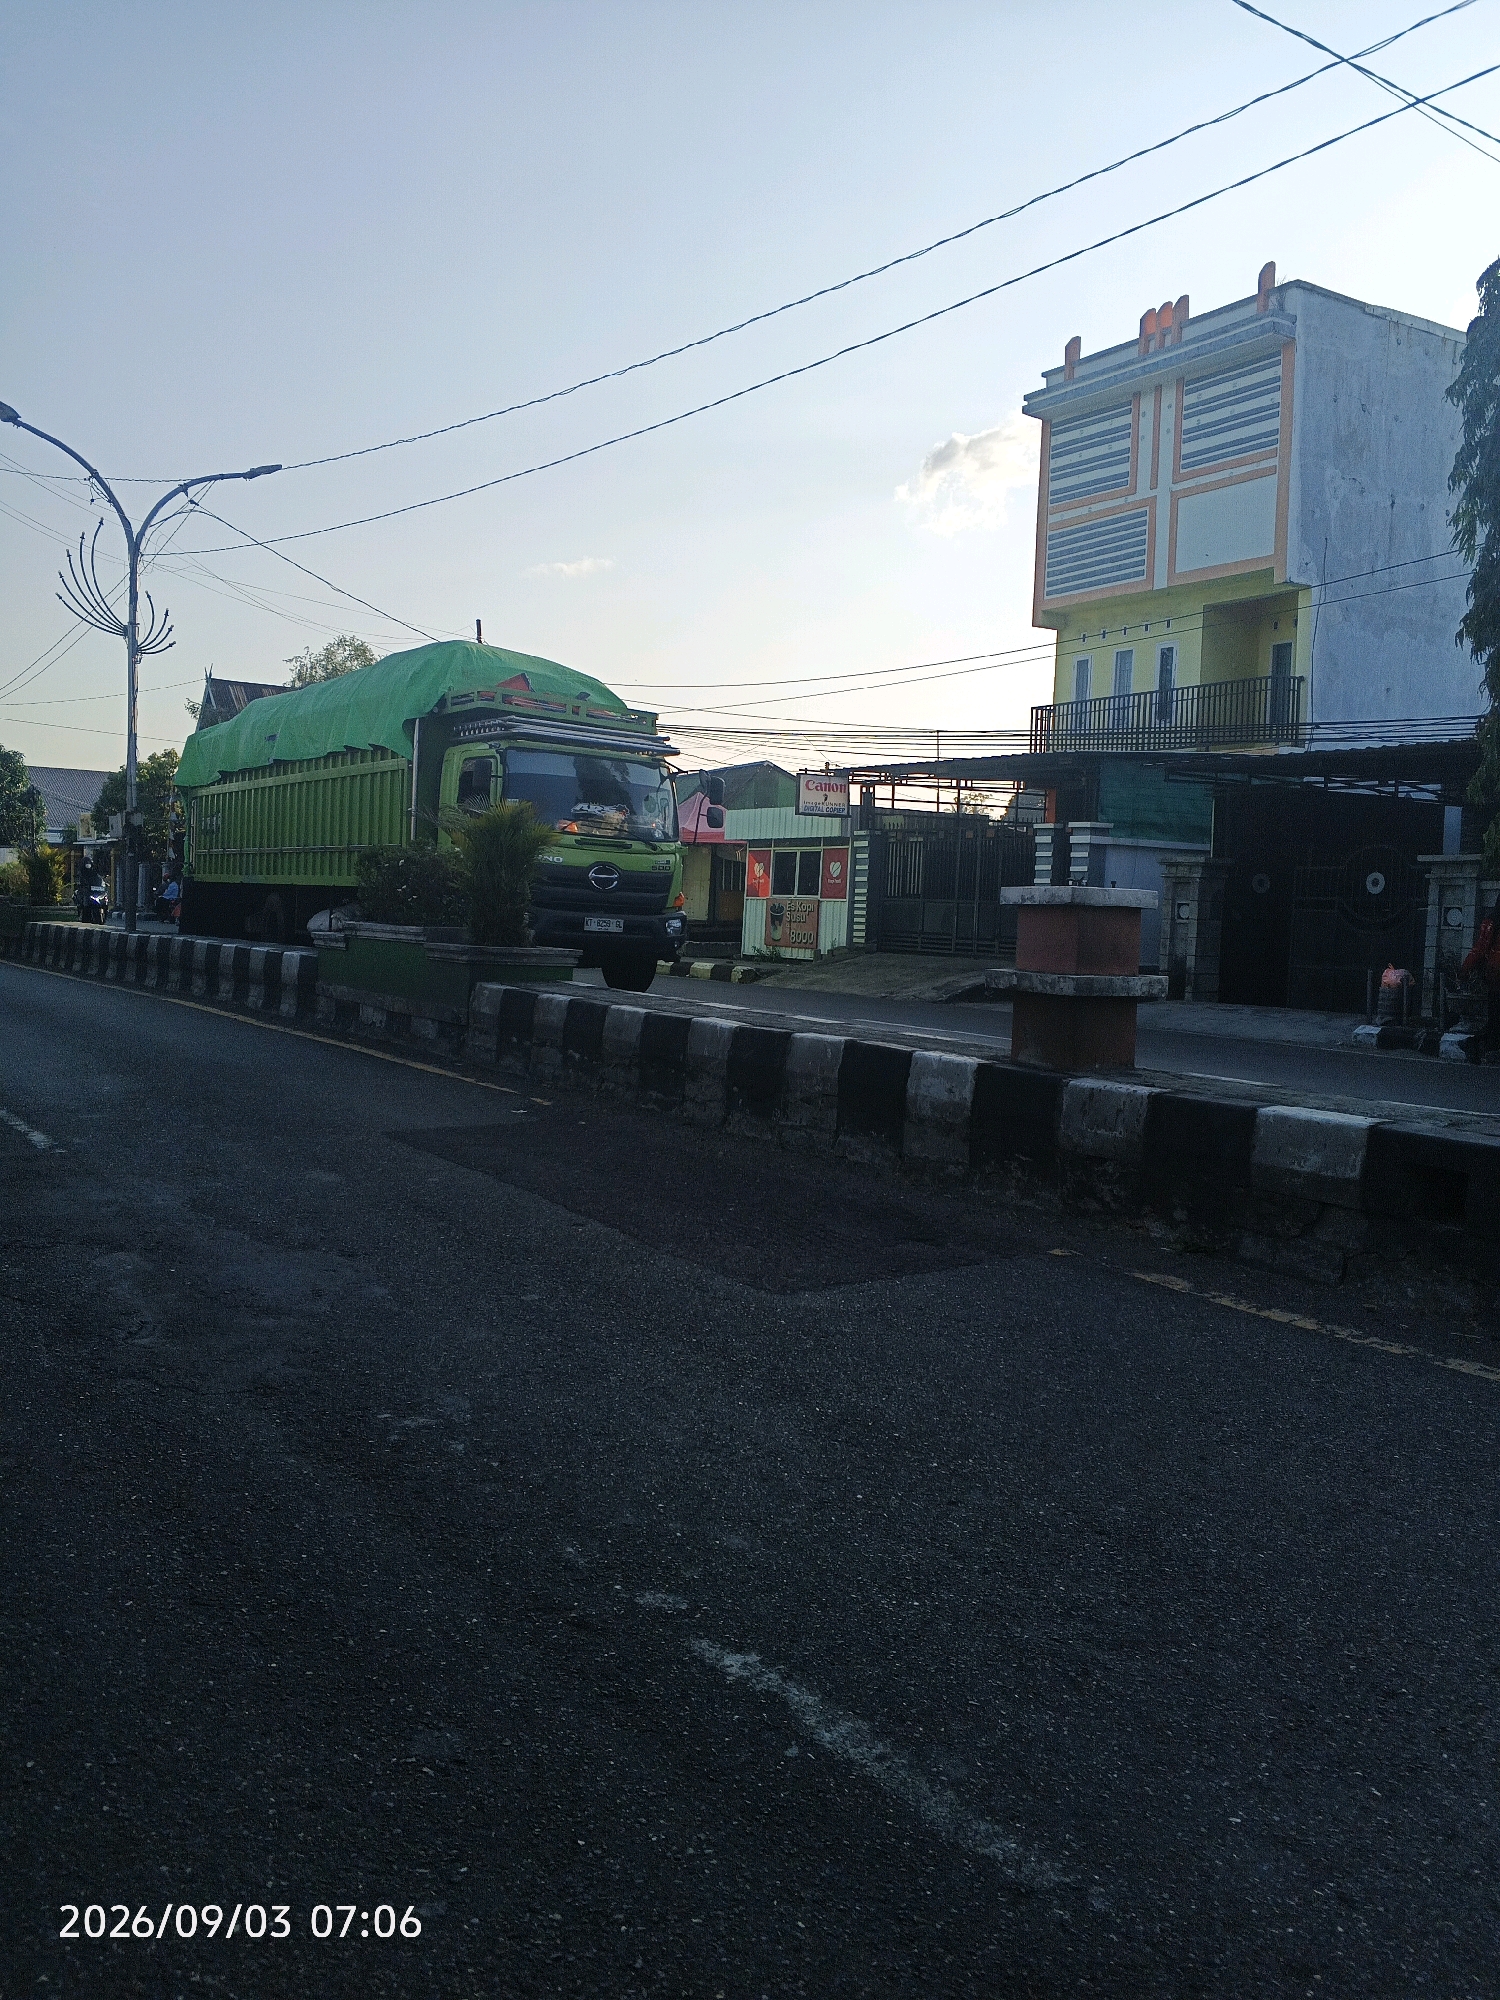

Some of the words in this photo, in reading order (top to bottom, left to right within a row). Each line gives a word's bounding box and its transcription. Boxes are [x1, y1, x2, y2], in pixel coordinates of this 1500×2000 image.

[805, 779, 847, 793] Canon
[803, 805, 825, 813] DIGITAL
[825, 806, 846, 814] COPIER
[786, 900, 796, 912] Es
[796, 901, 815, 916] Kopi
[786, 911, 807, 924] Susu
[790, 930, 815, 945] 8000
